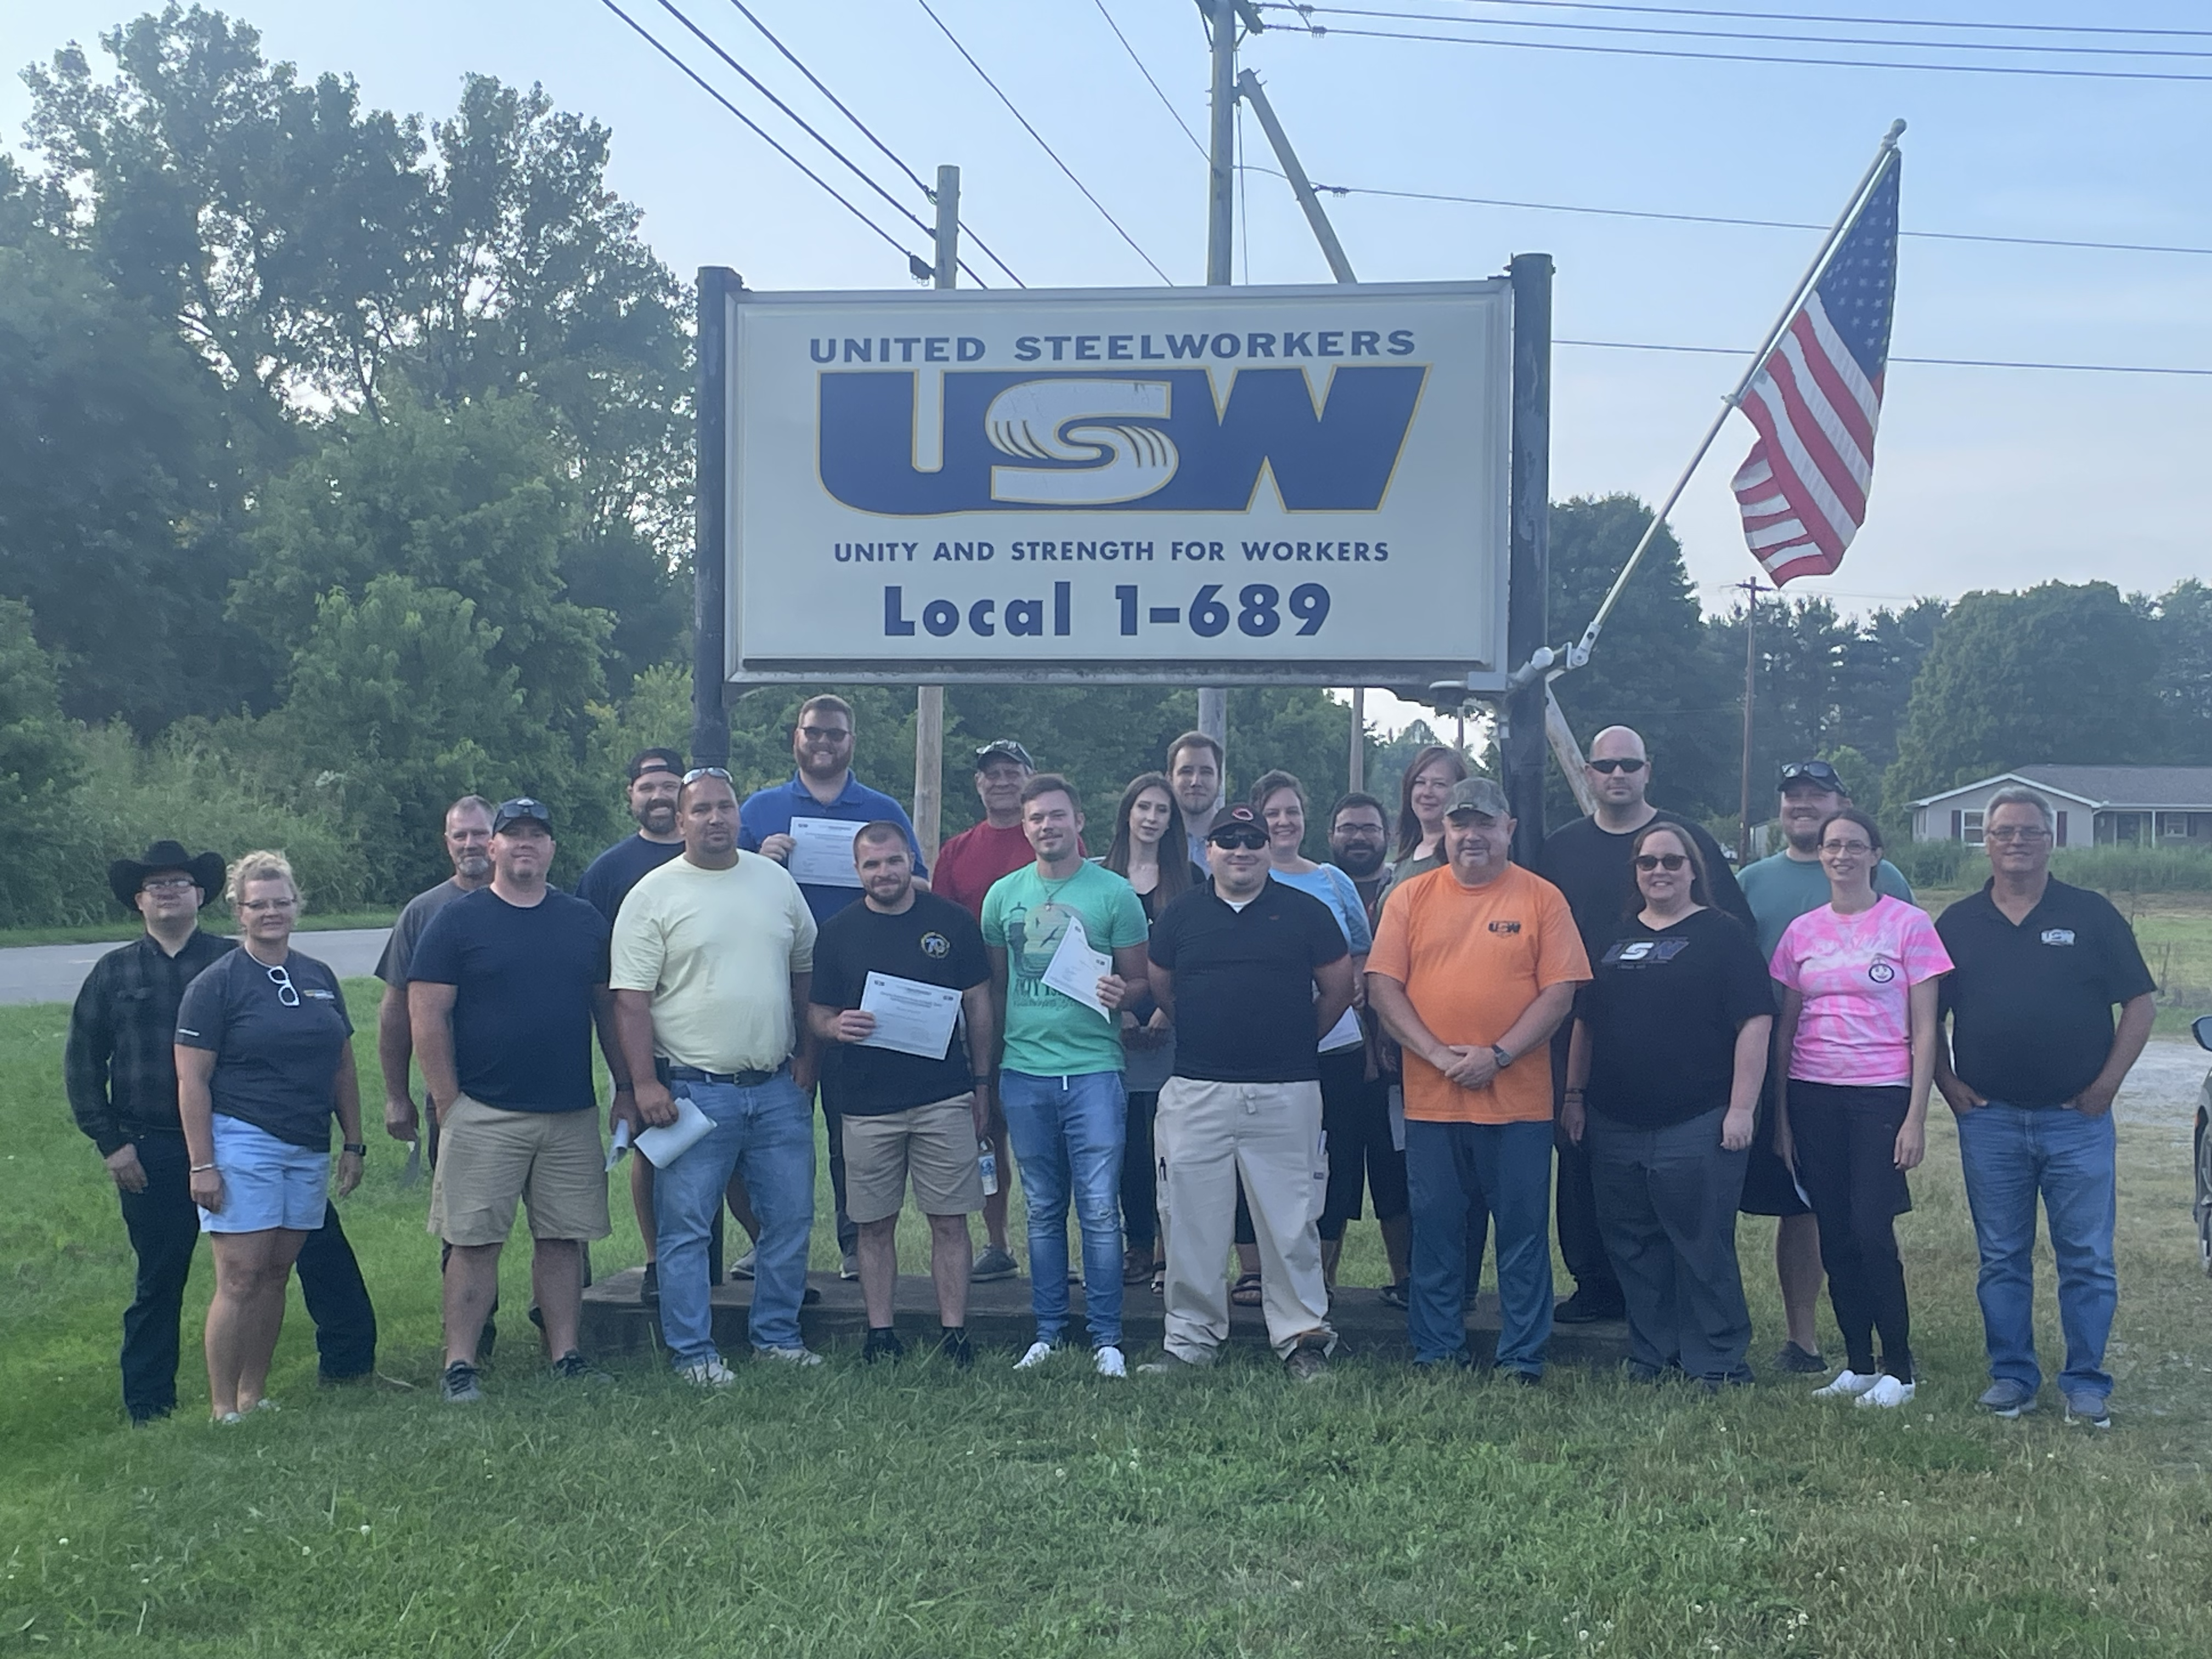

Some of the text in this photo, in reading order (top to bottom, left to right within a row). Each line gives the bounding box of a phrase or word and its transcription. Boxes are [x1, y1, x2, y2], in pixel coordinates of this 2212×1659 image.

[810, 329, 1415, 363] UNITED STEELWORKERS
[816, 363, 1434, 519] USW
[834, 540, 1389, 562] UNITY AND STRENGTH FOR WORKERS
[884, 581, 1331, 638] Local 1-689
[1488, 922, 1521, 934] USW
